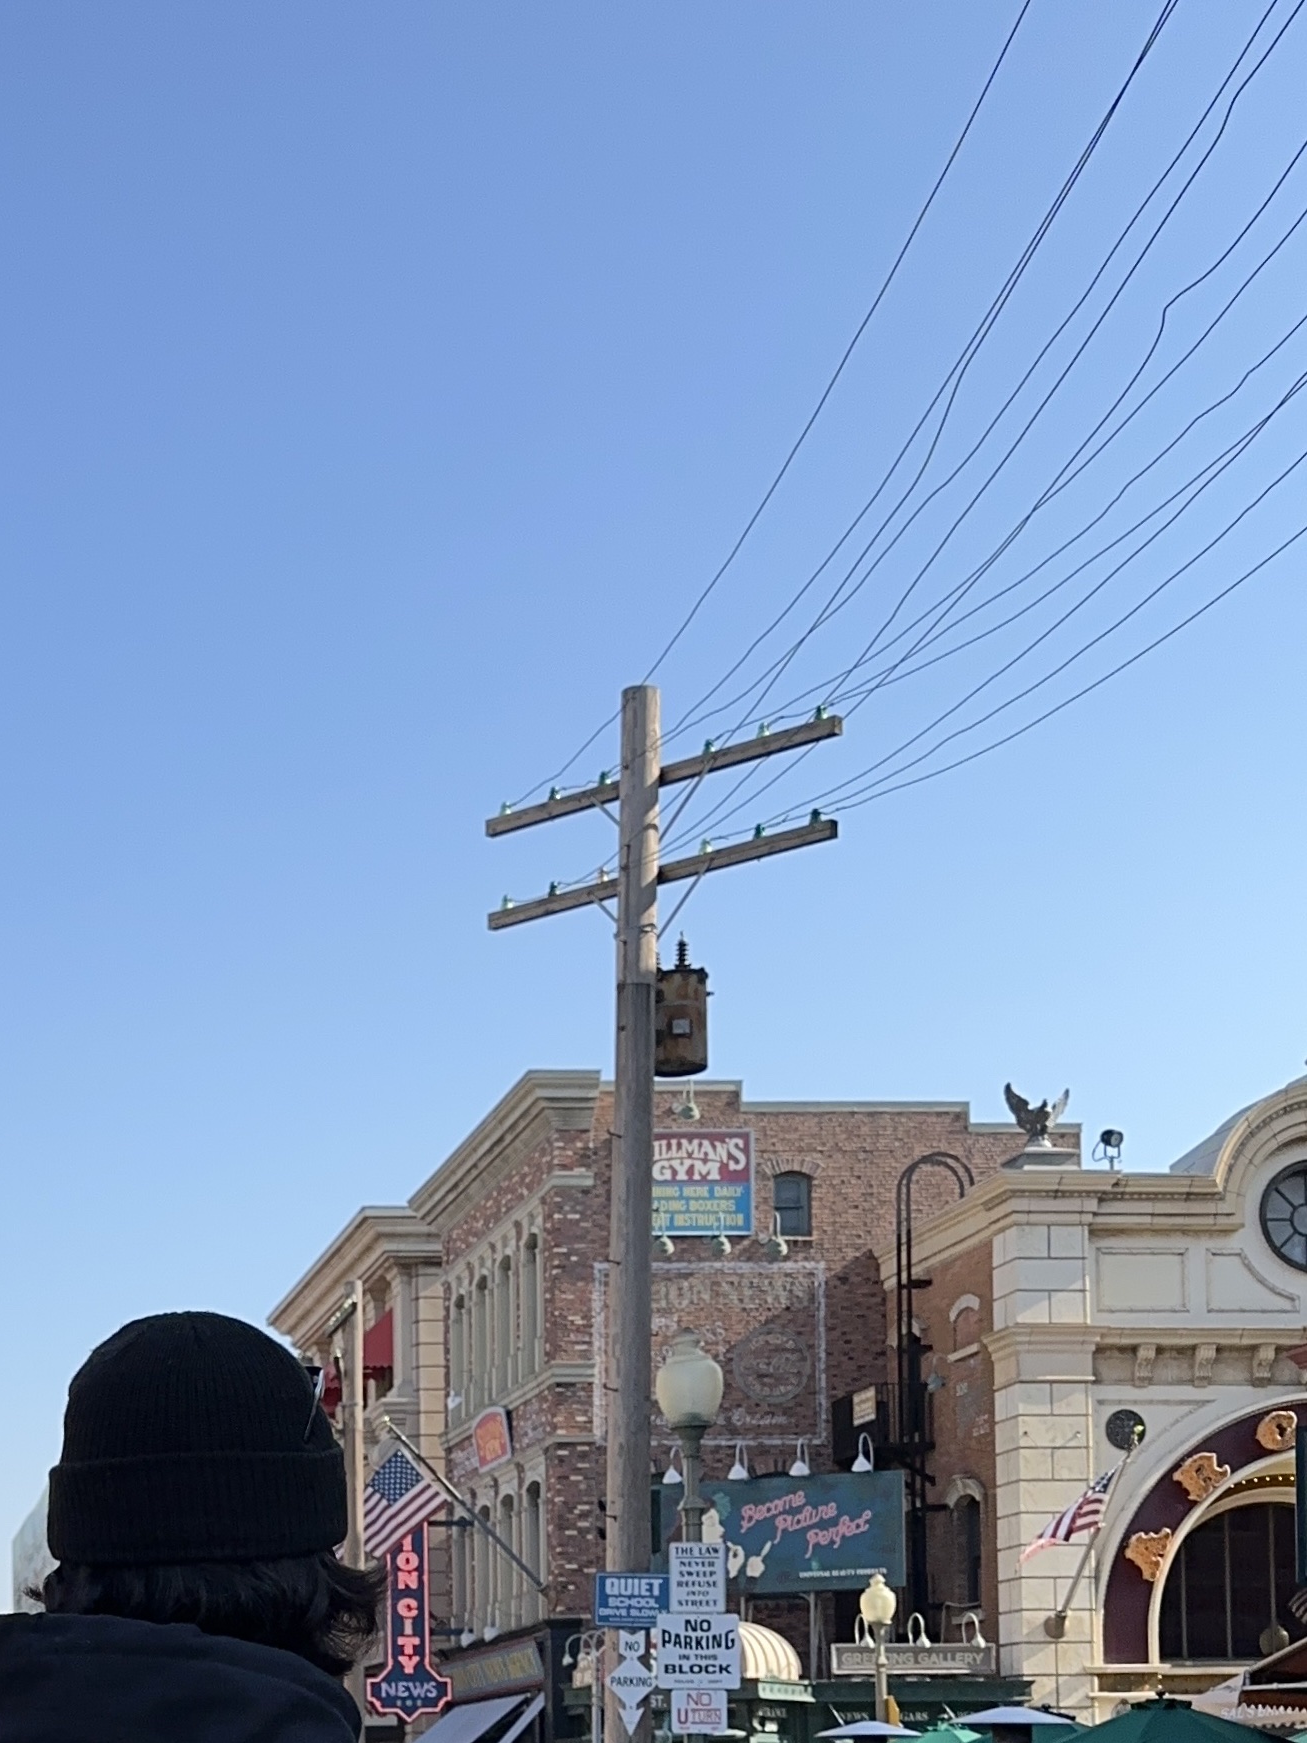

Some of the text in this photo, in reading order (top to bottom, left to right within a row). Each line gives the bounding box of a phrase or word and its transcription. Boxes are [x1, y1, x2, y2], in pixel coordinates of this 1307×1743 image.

[652, 1159, 721, 1181] GYM
[689, 1200, 735, 1211] BOXERS
[740, 1490, 807, 1533] Become
[773, 1502, 838, 1544] Picture
[804, 1510, 872, 1559] Perfect
[675, 1546, 721, 1556] THE LAW
[679, 1560, 716, 1568] NEVER
[678, 1570, 717, 1578] SWEEP
[605, 1577, 664, 1596] QUIET
[676, 1580, 719, 1588] REFUSE
[608, 1596, 660, 1608] SCHOOL
[677, 1599, 719, 1608] STREET
[598, 1607, 628, 1617] DRIVE
[684, 1619, 712, 1633] NO
[396, 1597, 421, 1674] CITY
[661, 1629, 736, 1651] PARKING
[624, 1640, 641, 1653] NO
[678, 1653, 719, 1661] IN THIS
[841, 1652, 985, 1666] GREEING GALLERY
[663, 1663, 733, 1675] BLOCK
[610, 1675, 654, 1688] PARKING
[380, 1681, 438, 1698] NEWS
[686, 1692, 713, 1707] NO
[676, 1707, 722, 1725] U TURN
